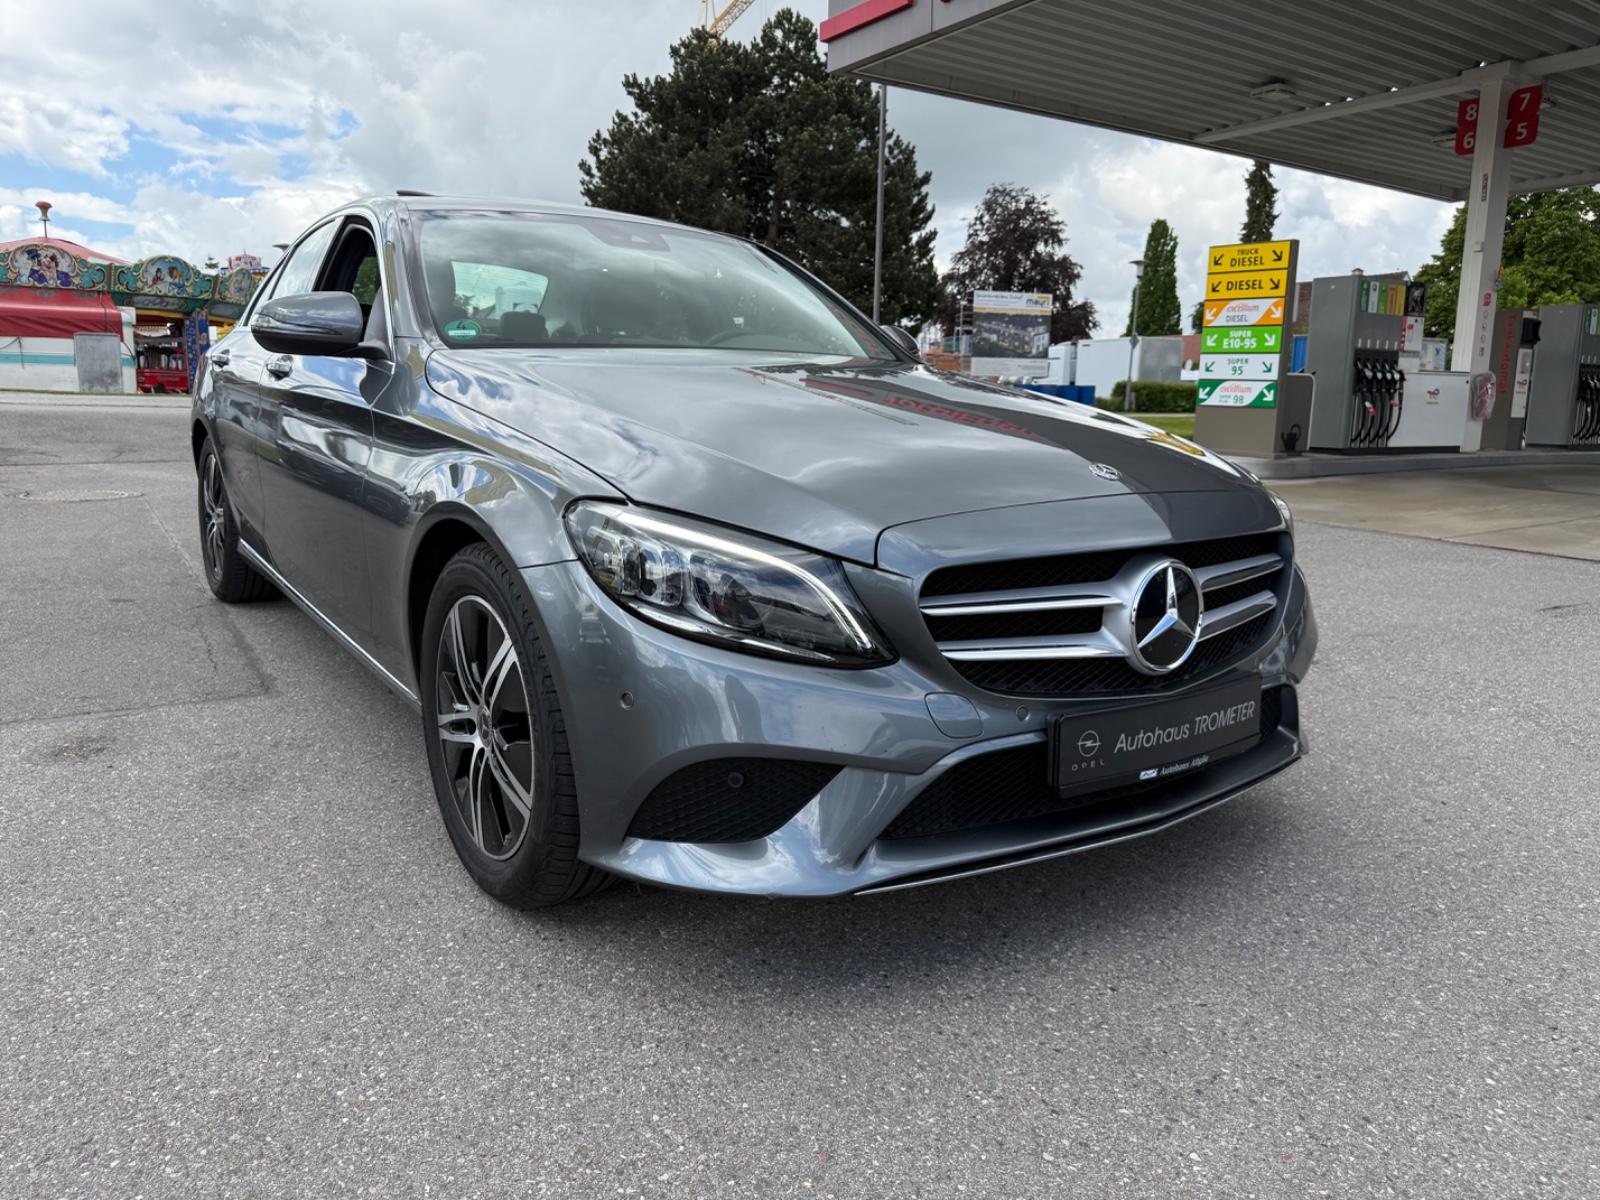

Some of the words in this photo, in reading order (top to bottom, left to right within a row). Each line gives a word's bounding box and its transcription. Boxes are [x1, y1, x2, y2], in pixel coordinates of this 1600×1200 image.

[1519, 92, 1532, 112] 7
[1465, 104, 1478, 121] 8
[1515, 122, 1529, 140] 5
[1463, 132, 1474, 149] 6
[1230, 256, 1265, 267] DIESEL
[1226, 279, 1264, 291] DIESEL
[1225, 314, 1248, 323] DIESEL
[456, 321, 466, 330] 4
[1230, 330, 1252, 338] SUPER
[1222, 338, 1257, 349] E10-95
[1231, 365, 1243, 376] 95
[1233, 395, 1244, 404] 98
[1113, 723, 1190, 754] Autohaus
[1194, 700, 1256, 736] TROMETER
[1071, 759, 1105, 771] OPEL
